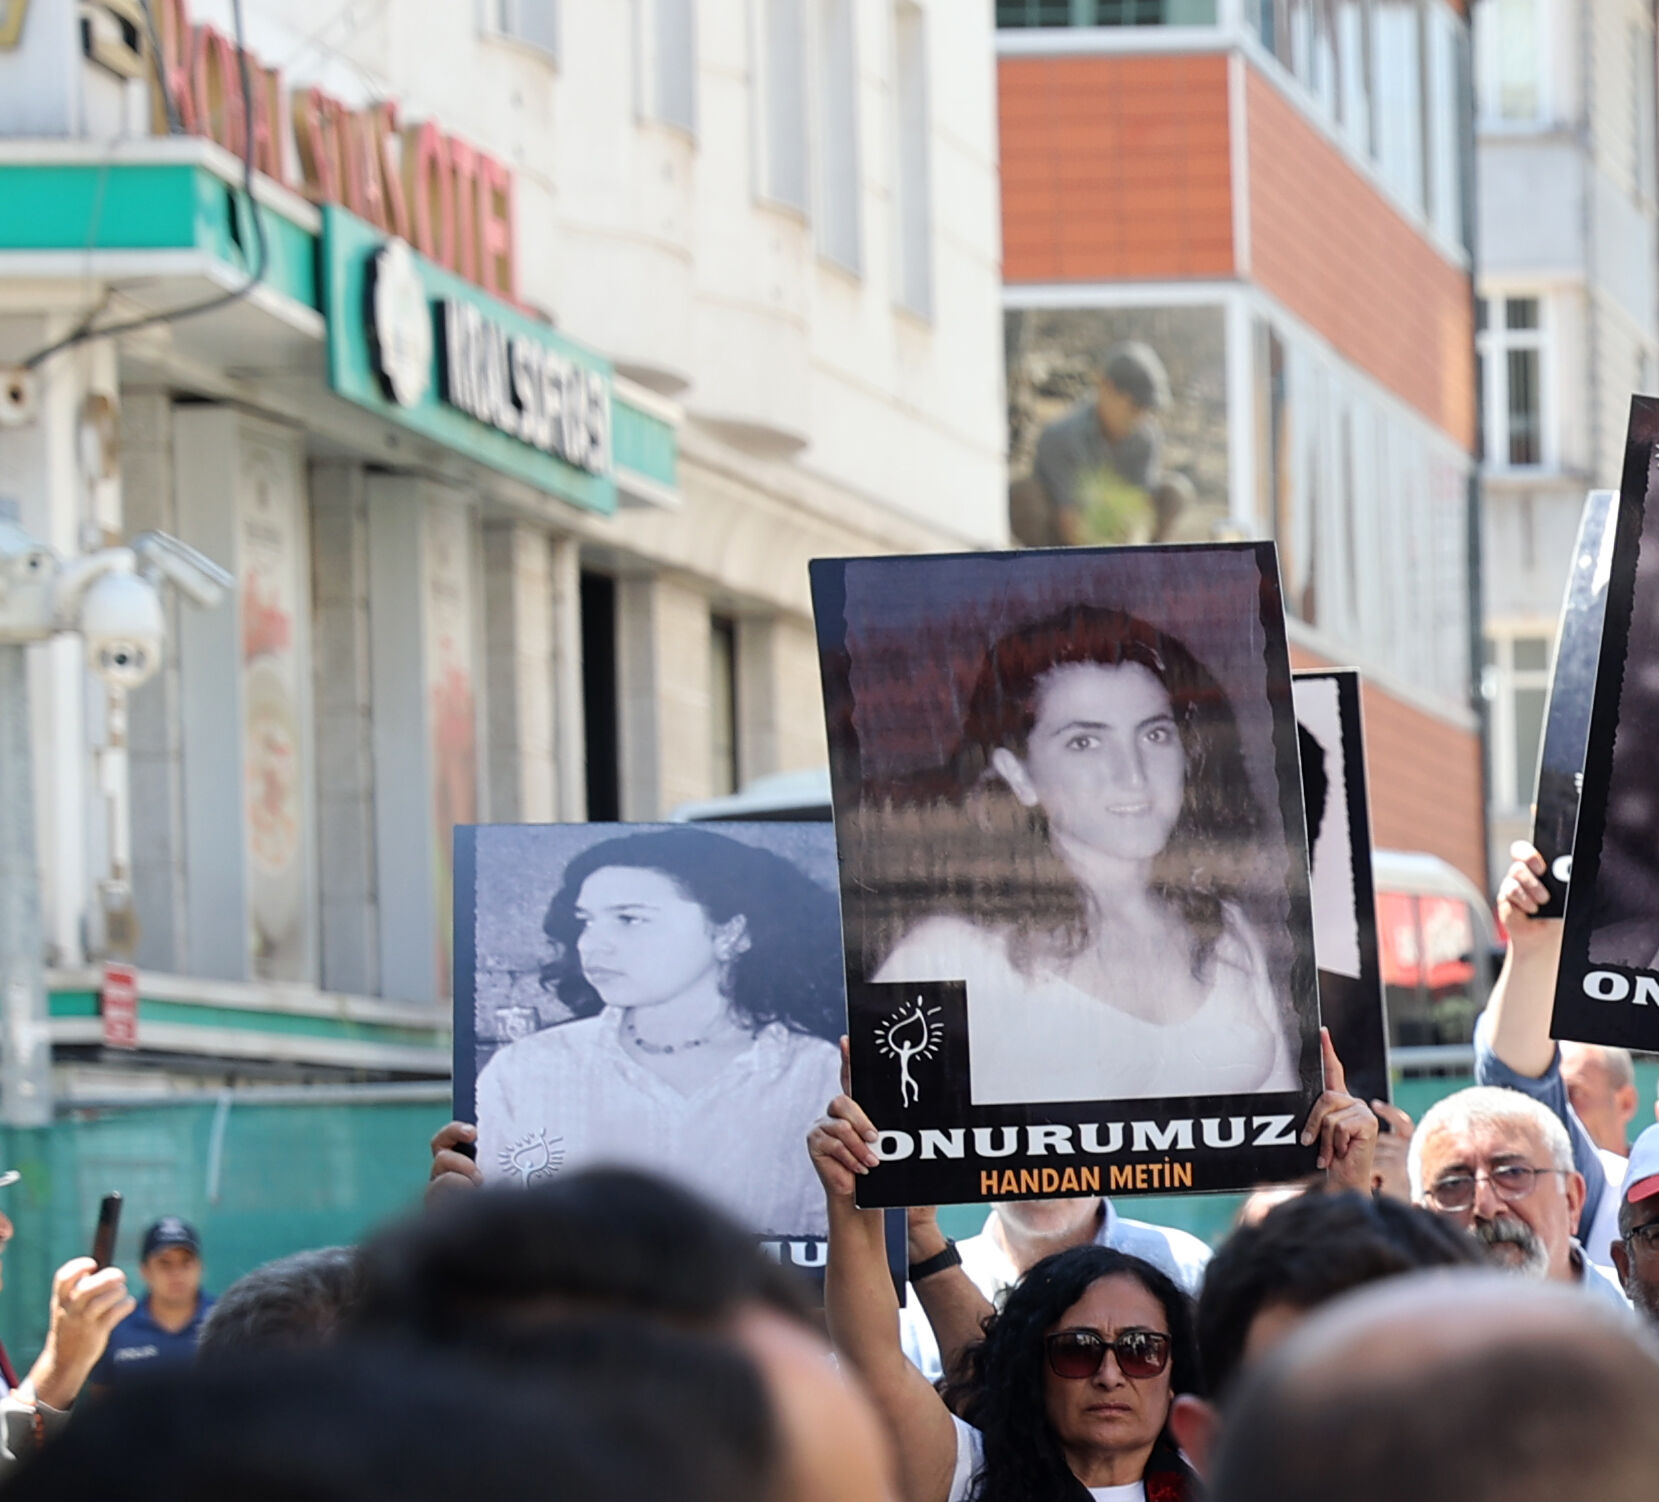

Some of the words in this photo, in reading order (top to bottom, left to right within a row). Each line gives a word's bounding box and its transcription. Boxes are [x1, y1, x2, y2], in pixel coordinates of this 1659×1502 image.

[875, 1114, 1297, 1162] ONURUMUZ
[979, 1166, 1101, 1196] HANDAN
[1109, 1156, 1193, 1190] METİN
